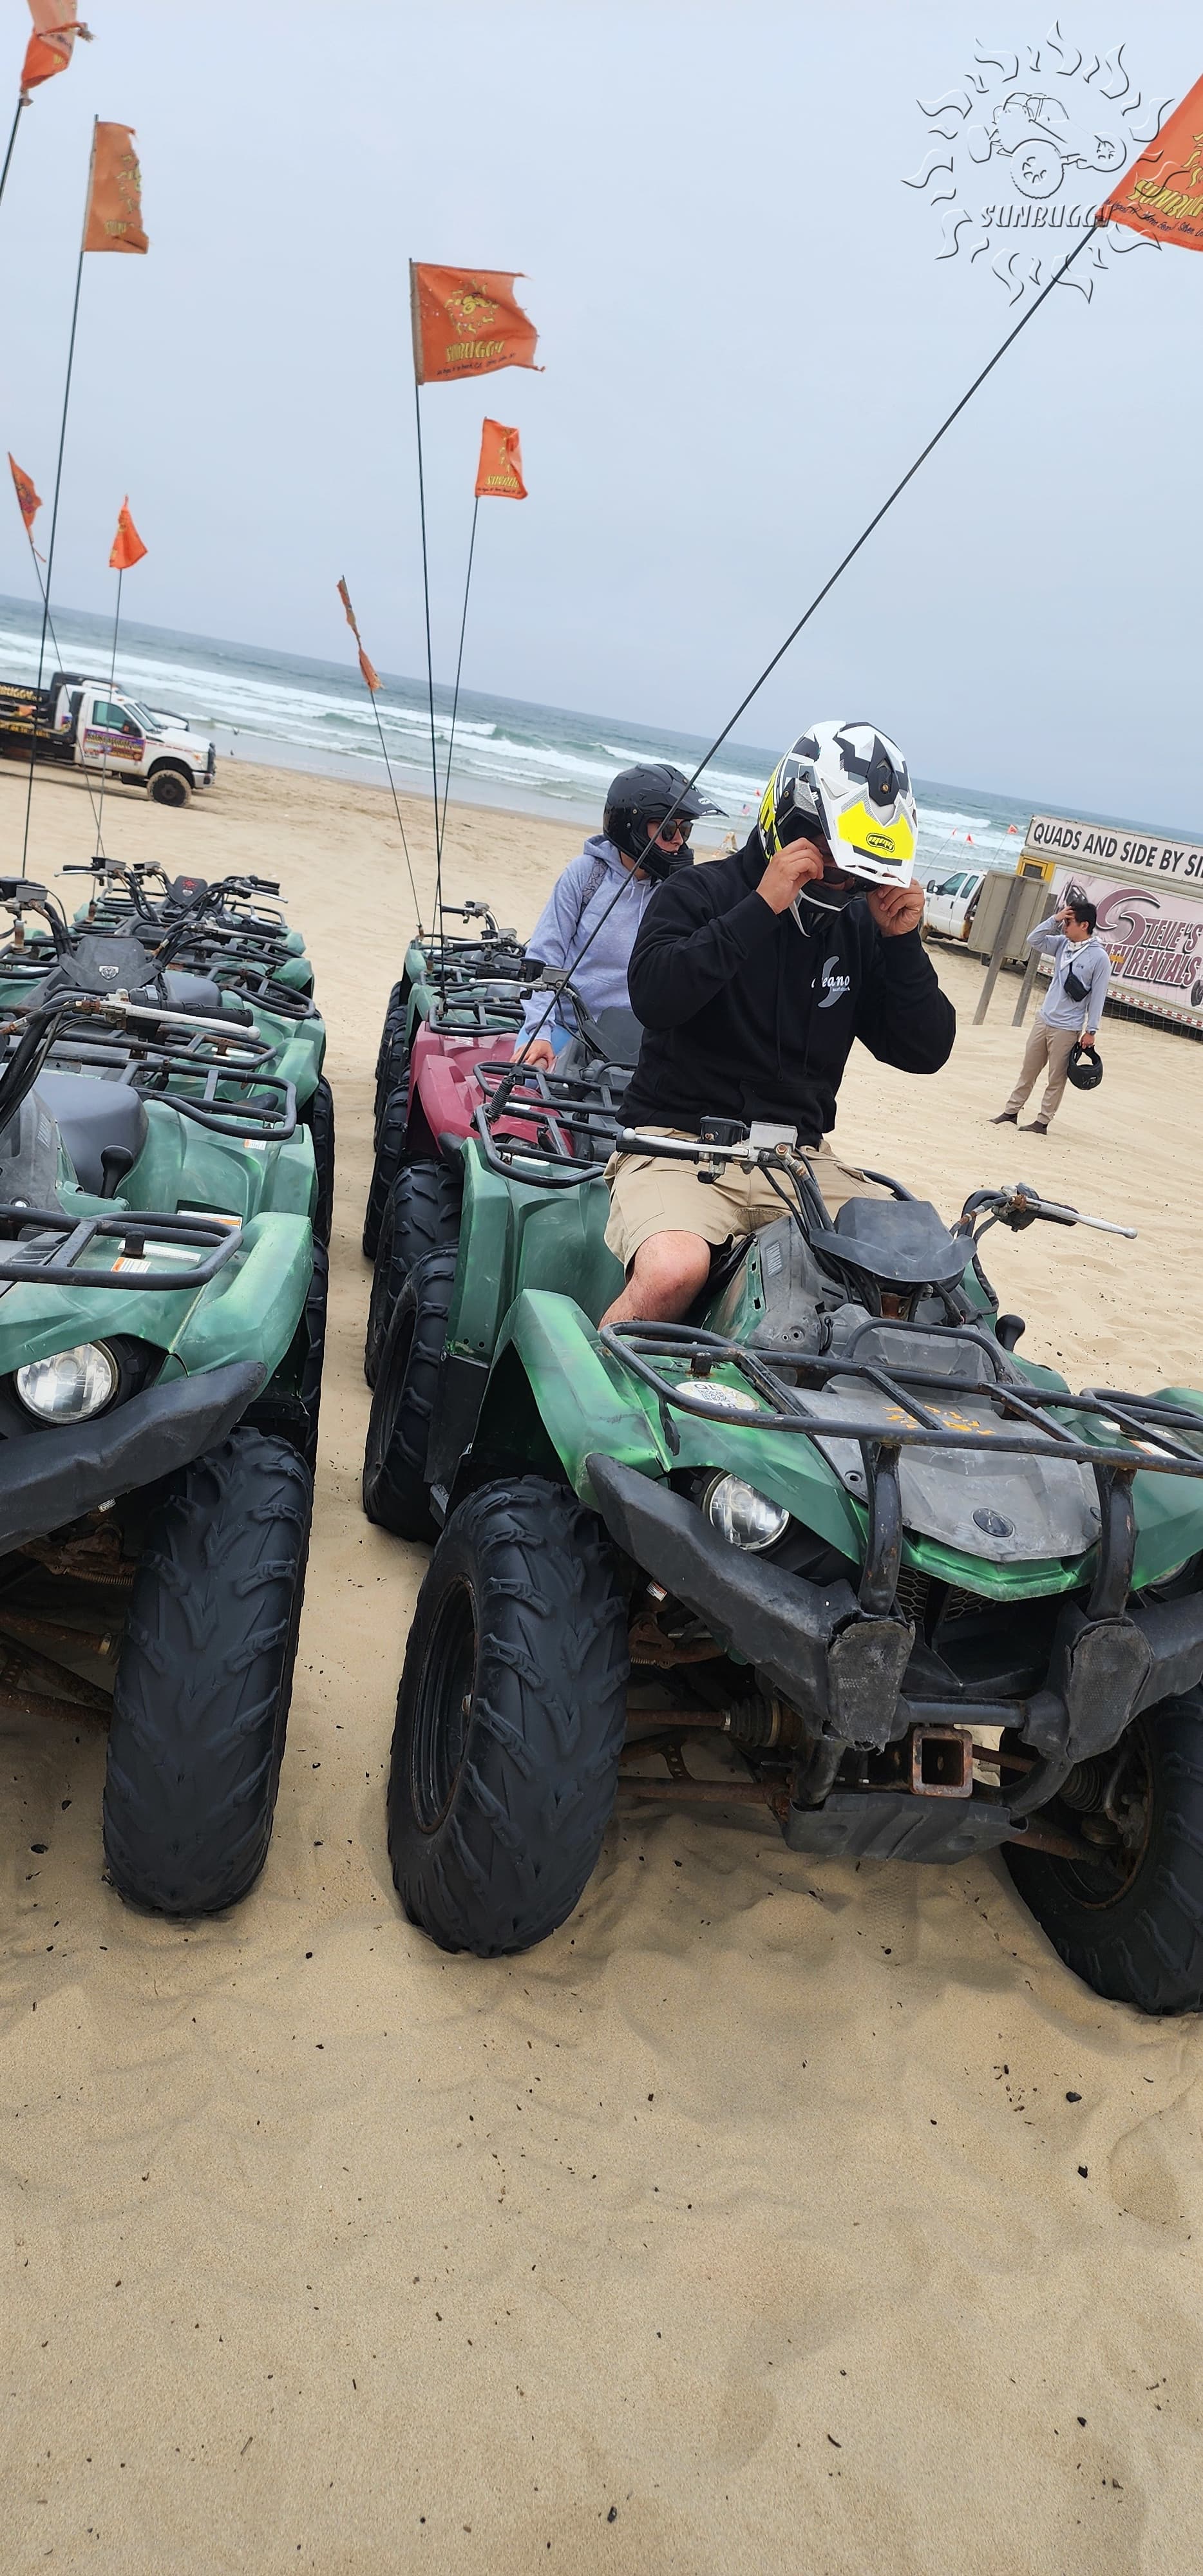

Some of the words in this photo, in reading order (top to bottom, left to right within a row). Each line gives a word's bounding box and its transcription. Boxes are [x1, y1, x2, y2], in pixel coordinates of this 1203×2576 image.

[1034, 822, 1083, 851] QUADS
[1082, 833, 1118, 858] AND
[1119, 840, 1158, 867] SIDE
[1159, 849, 1185, 873] BY
[1184, 853, 1203, 878] SI
[1123, 945, 1202, 988] RENTALS
